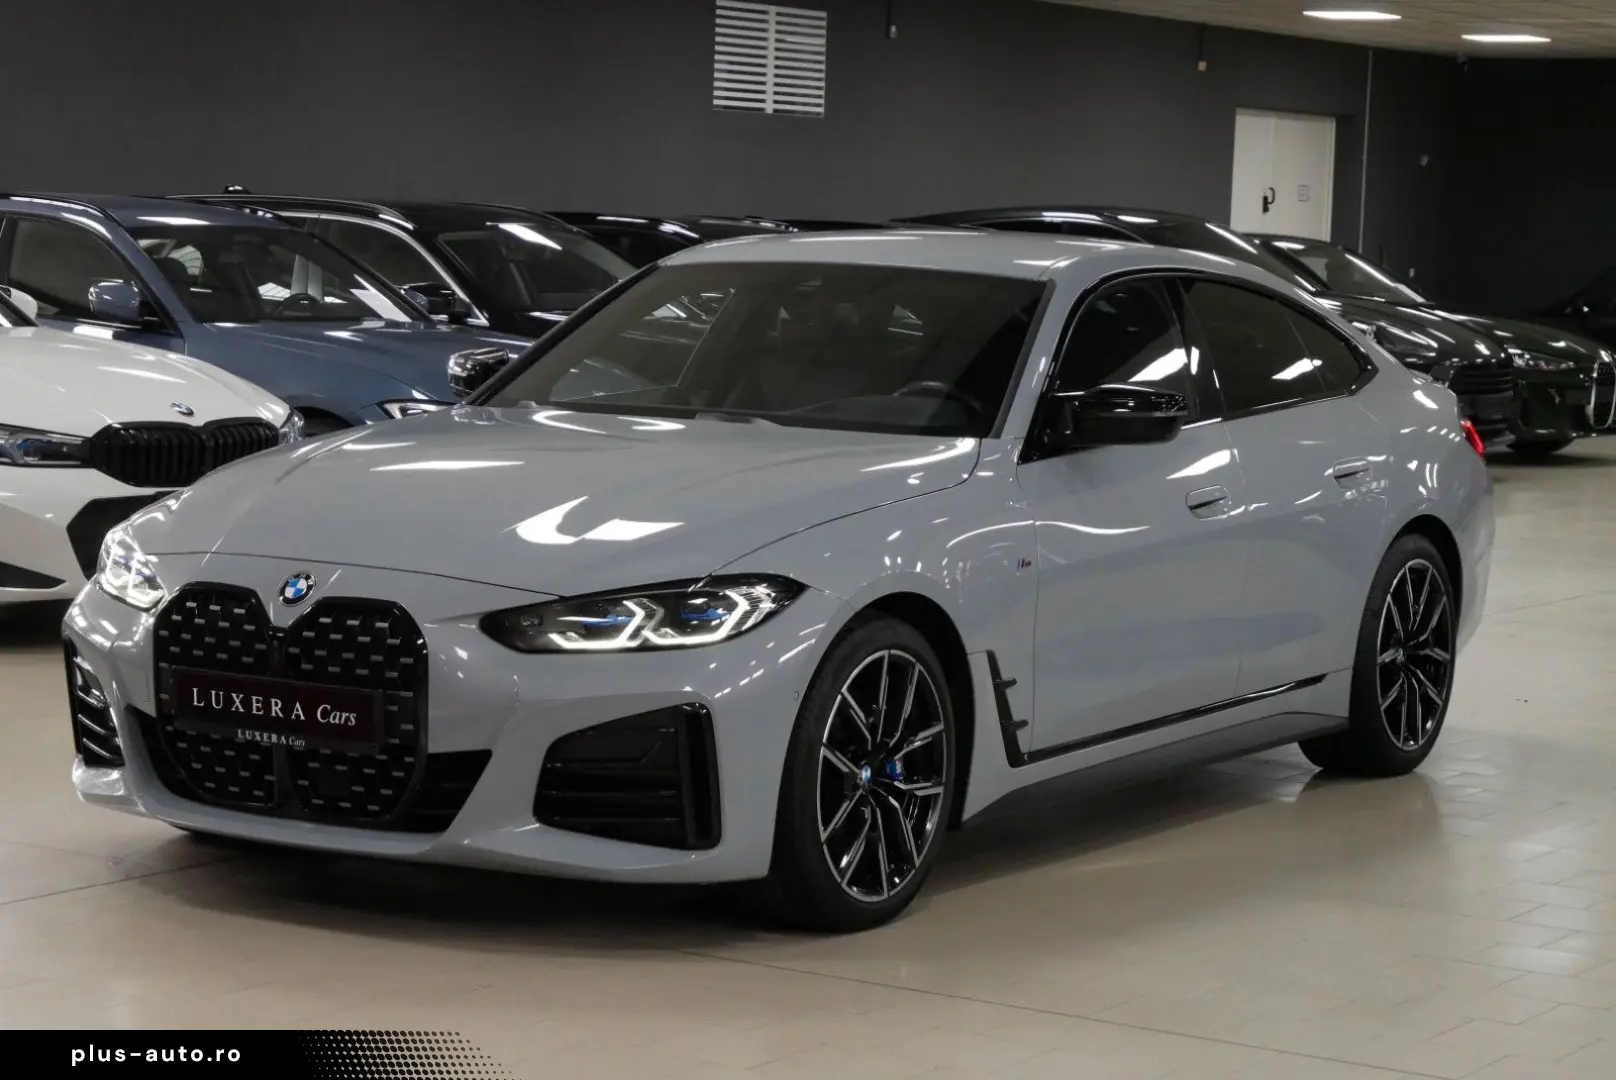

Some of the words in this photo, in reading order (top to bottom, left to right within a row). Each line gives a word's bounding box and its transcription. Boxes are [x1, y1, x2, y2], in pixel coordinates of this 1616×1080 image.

[192, 687, 306, 720] LUXERA
[316, 704, 357, 726] Cars
[237, 729, 287, 745] LUXERA
[289, 736, 306, 748] Cars
